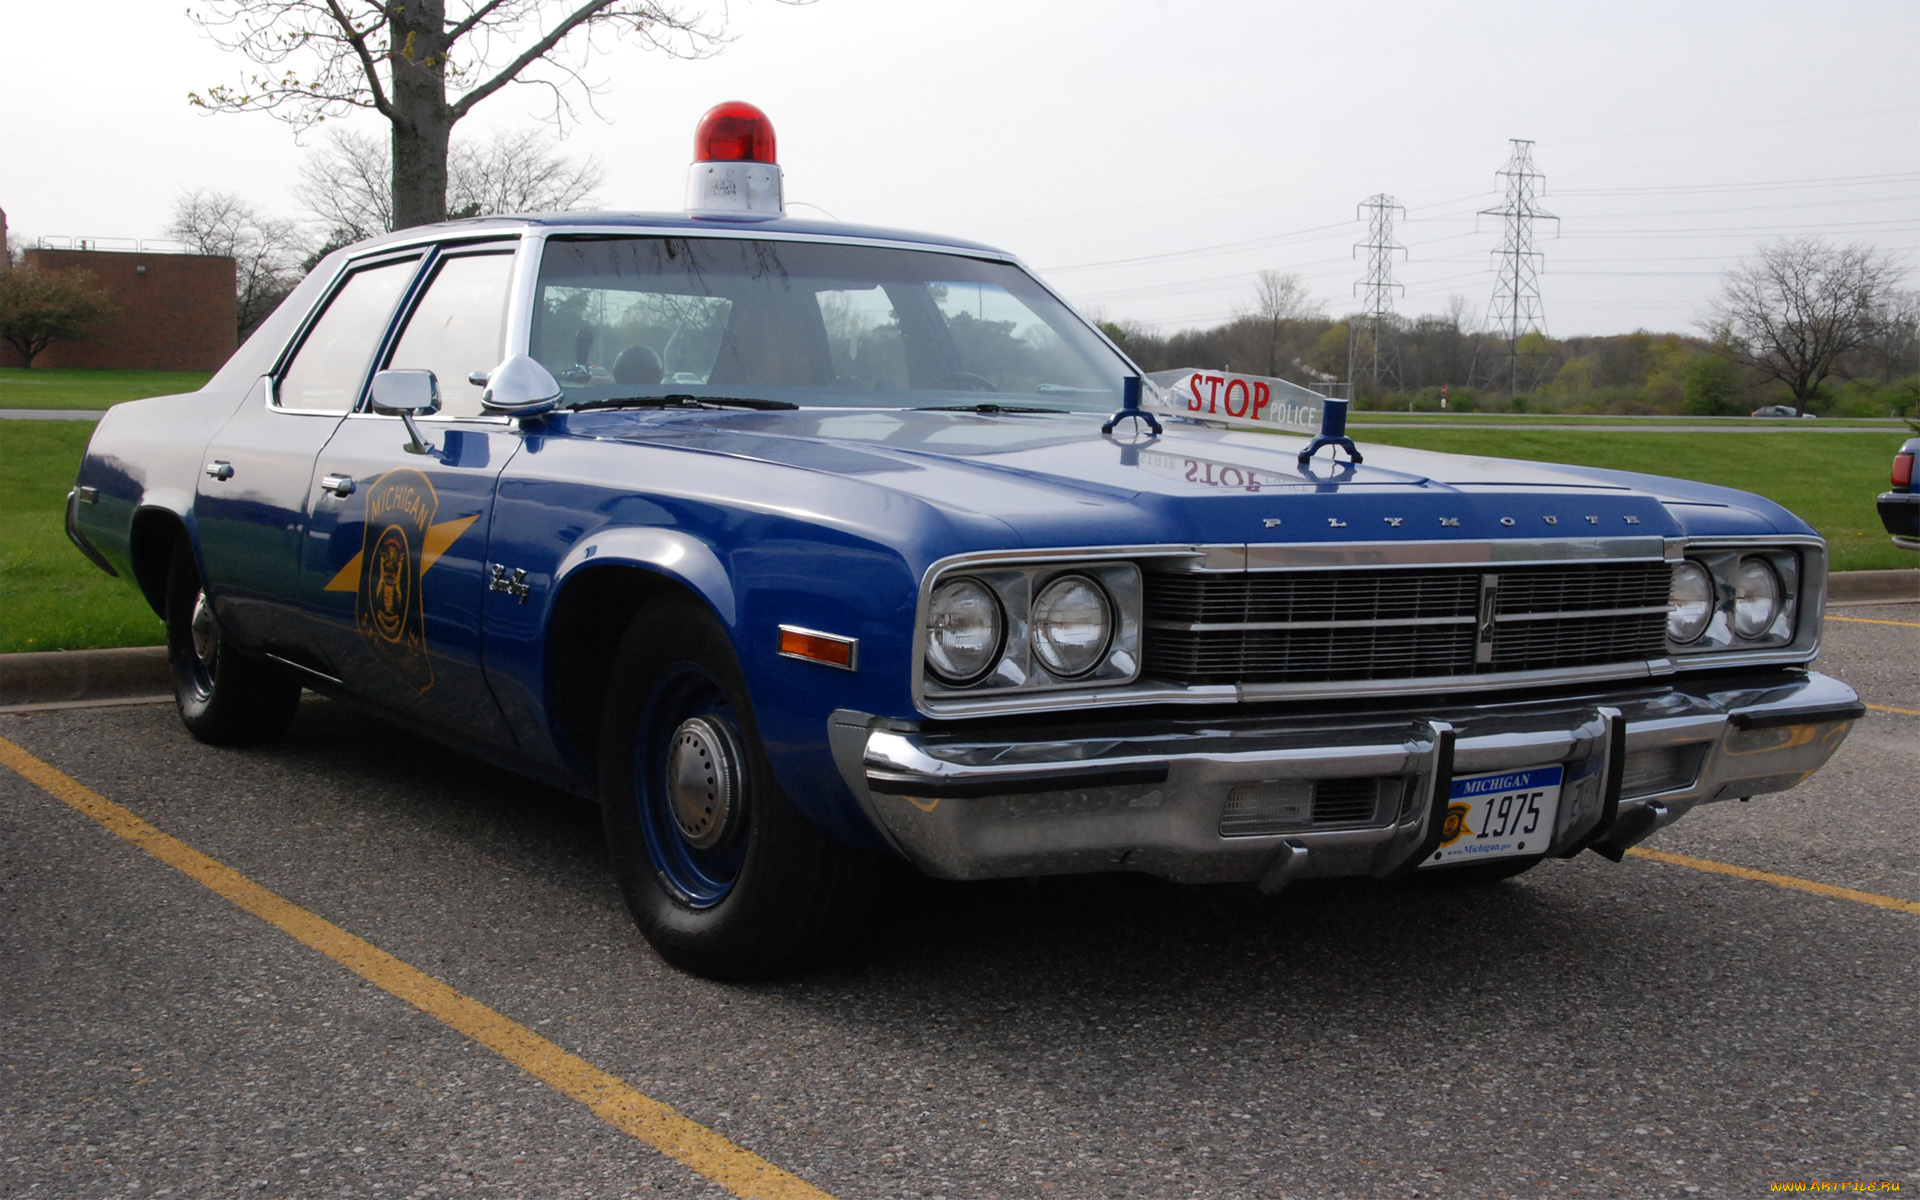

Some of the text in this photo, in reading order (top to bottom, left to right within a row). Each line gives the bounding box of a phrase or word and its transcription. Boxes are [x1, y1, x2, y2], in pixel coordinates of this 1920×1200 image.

[1188, 373, 1270, 420] STOP
[1270, 403, 1316, 427] POLICE
[371, 485, 429, 531] MICHIGAN
[1262, 515, 1640, 528] PLYMOUTH
[1463, 773, 1531, 794] MICHIGAN
[1476, 792, 1543, 839] 1975
